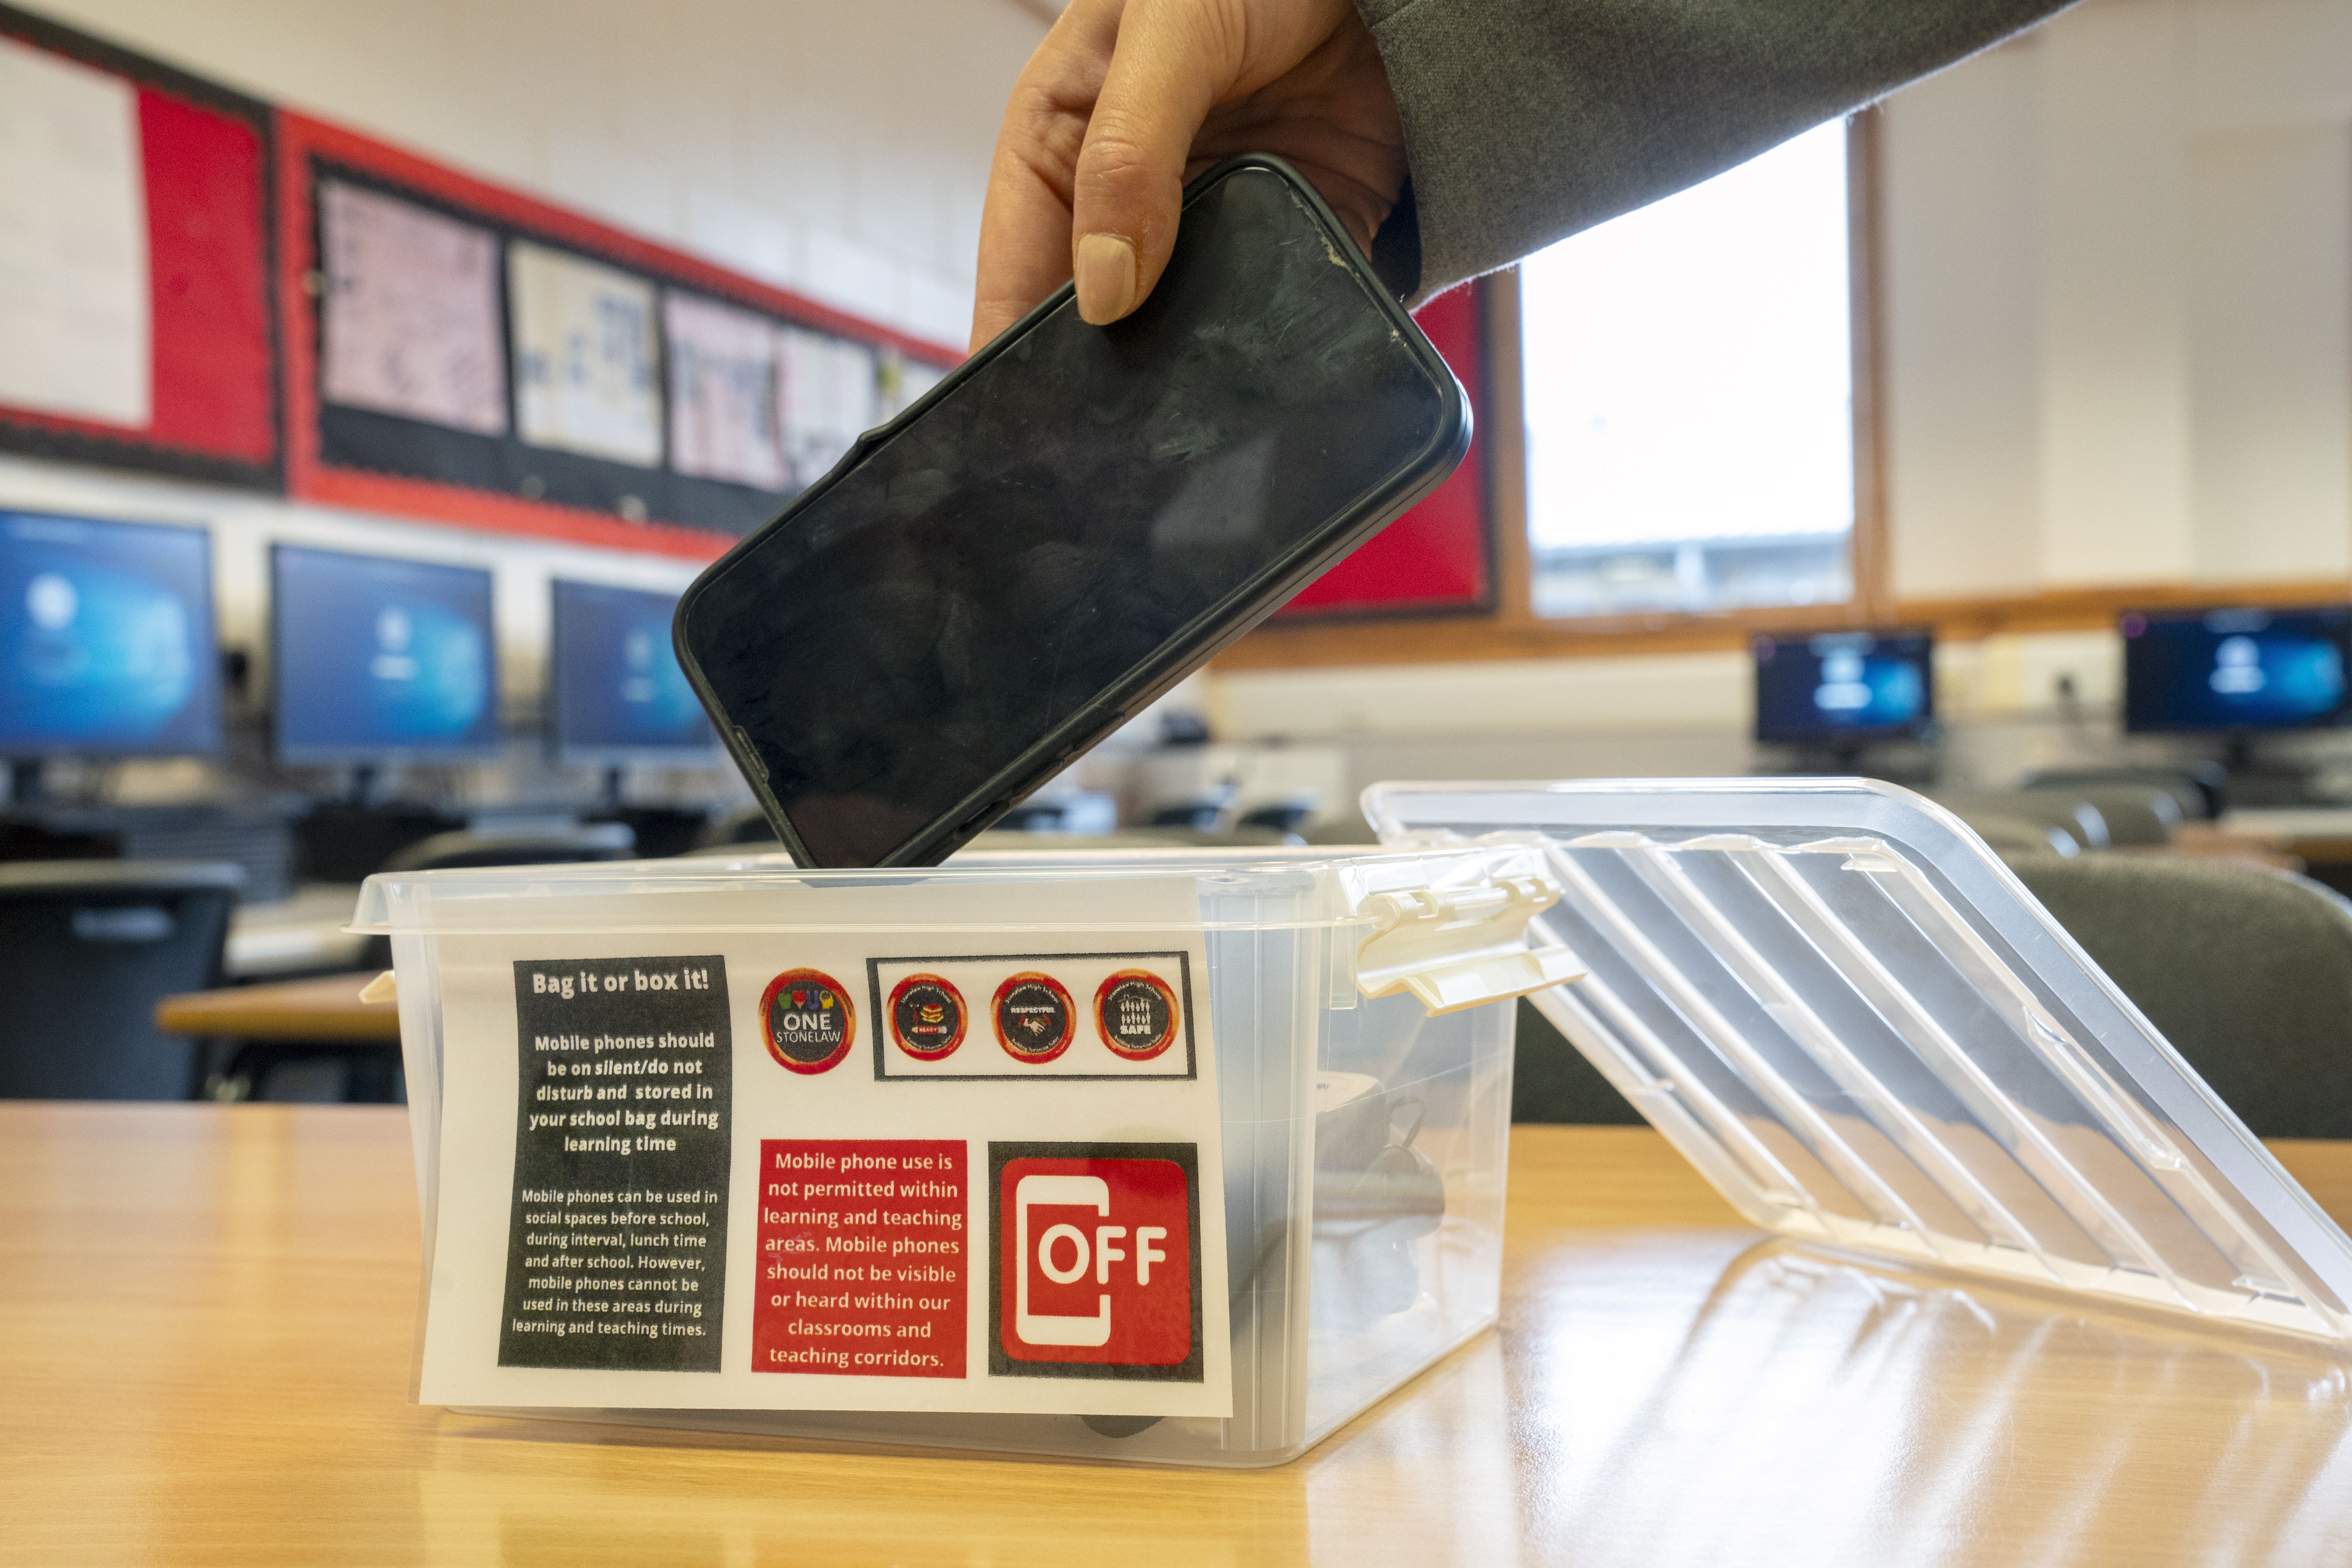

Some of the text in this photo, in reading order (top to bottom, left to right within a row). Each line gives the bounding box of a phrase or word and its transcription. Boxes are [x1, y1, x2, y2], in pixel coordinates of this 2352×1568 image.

[533, 969, 708, 999] Bag it or box it!
[784, 1013, 831, 1031] ONE
[1120, 1025, 1151, 1035] SAFE
[535, 1033, 714, 1054] Mobile phones should
[777, 1031, 840, 1043] STONELAW
[548, 1059, 702, 1076] be on silent/do not
[537, 1084, 712, 1100] disturb and stored in
[530, 1110, 719, 1131] your school bag during
[565, 1136, 676, 1155] learning time
[776, 1153, 952, 1173] Mobile phone use is
[522, 1190, 717, 1206] Mobile phones can be used in
[769, 1181, 957, 1200] not permitted within
[526, 1211, 709, 1228] social spaces before school,
[764, 1207, 962, 1230] learning and teaching
[527, 1232, 706, 1249] during interval, lunch time
[766, 1236, 959, 1257] areas. Mobile phones
[525, 1254, 705, 1271] and after school. However,
[1038, 1223, 1167, 1286] OFF
[768, 1263, 956, 1281] should not be visible
[529, 1276, 698, 1293] mobile phones cannot be
[523, 1298, 702, 1318] used in these areas during
[771, 1291, 950, 1310] or heard within our
[513, 1319, 706, 1338] learning and teaching times.
[788, 1319, 931, 1338] classrooms and
[770, 1347, 943, 1368] teaching corridors.
